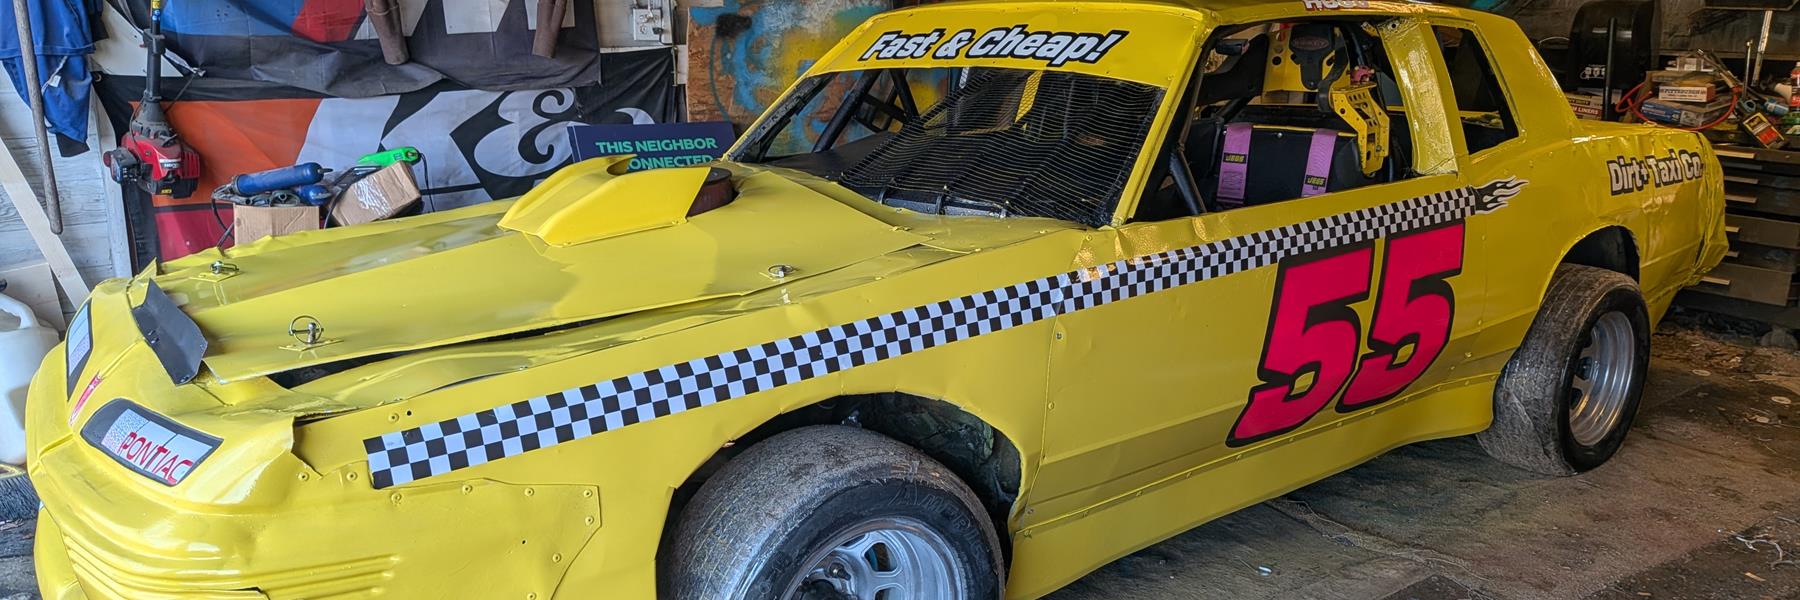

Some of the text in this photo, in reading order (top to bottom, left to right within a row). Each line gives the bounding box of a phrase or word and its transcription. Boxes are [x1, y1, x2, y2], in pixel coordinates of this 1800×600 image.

[860, 24, 1129, 67] Fast & Cheap!
[596, 138, 718, 154] THIS NEIGHBOR
[627, 154, 714, 171] ONNECTED
[1645, 149, 1683, 188] Taxi
[1225, 219, 1465, 447] 55
[116, 431, 193, 485] PONTIAC
